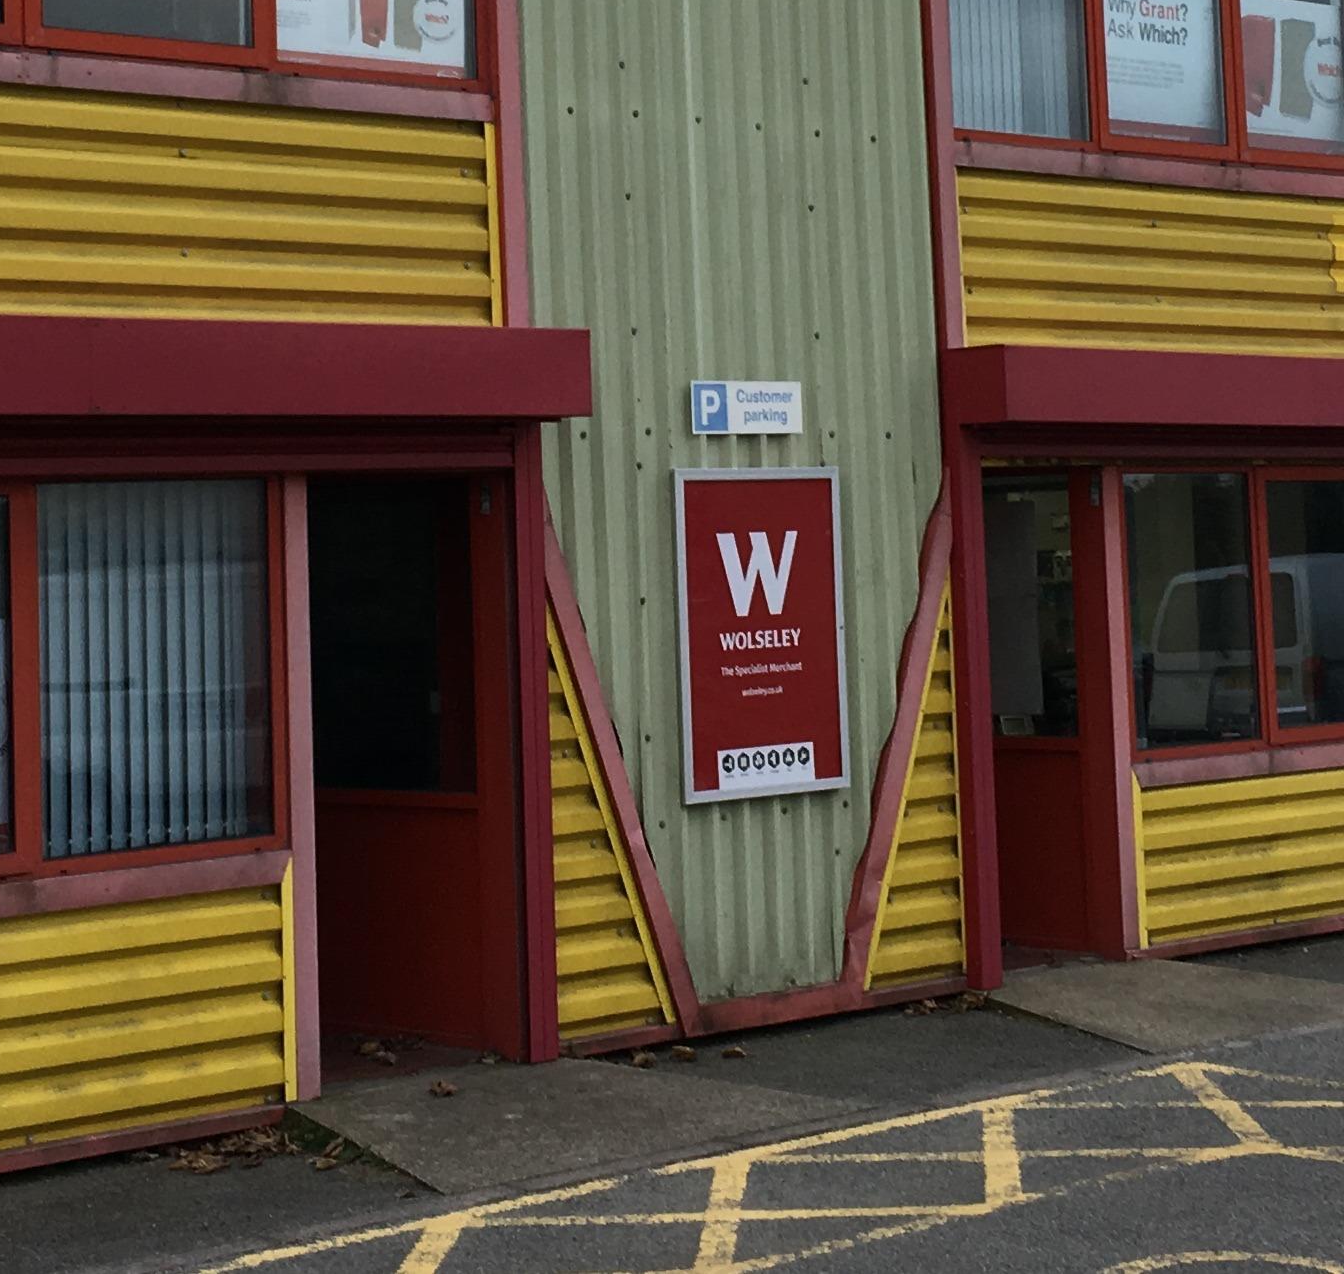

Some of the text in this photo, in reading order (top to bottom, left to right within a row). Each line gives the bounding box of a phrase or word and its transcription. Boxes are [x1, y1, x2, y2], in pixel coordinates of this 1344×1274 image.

[1107, 18, 1189, 46] Ask Which?
[700, 388, 793, 426] P Customer
[743, 408, 788, 425] parking
[716, 530, 798, 617] W
[719, 627, 801, 652] WOLSELEY
[720, 661, 803, 677] The Specialist Merchant
